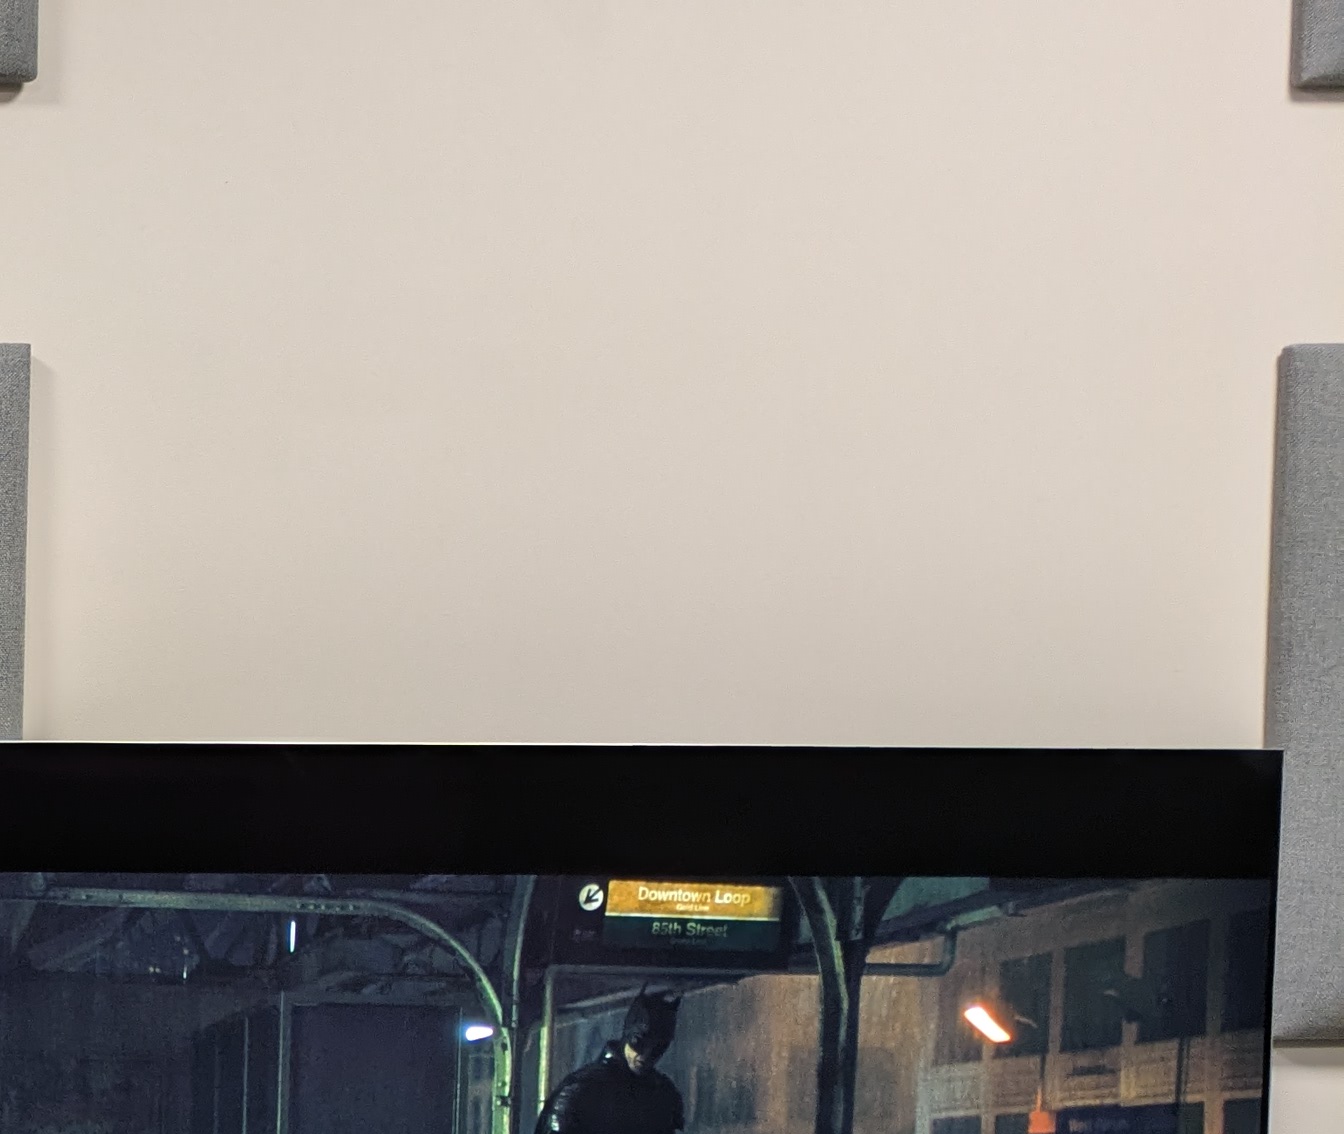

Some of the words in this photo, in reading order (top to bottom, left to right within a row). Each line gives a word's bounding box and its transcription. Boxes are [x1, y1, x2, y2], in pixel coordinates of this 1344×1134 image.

[638, 886, 711, 902] Downtown
[714, 889, 751, 907] Loop
[651, 921, 682, 936] 85th
[685, 921, 728, 938] Street
